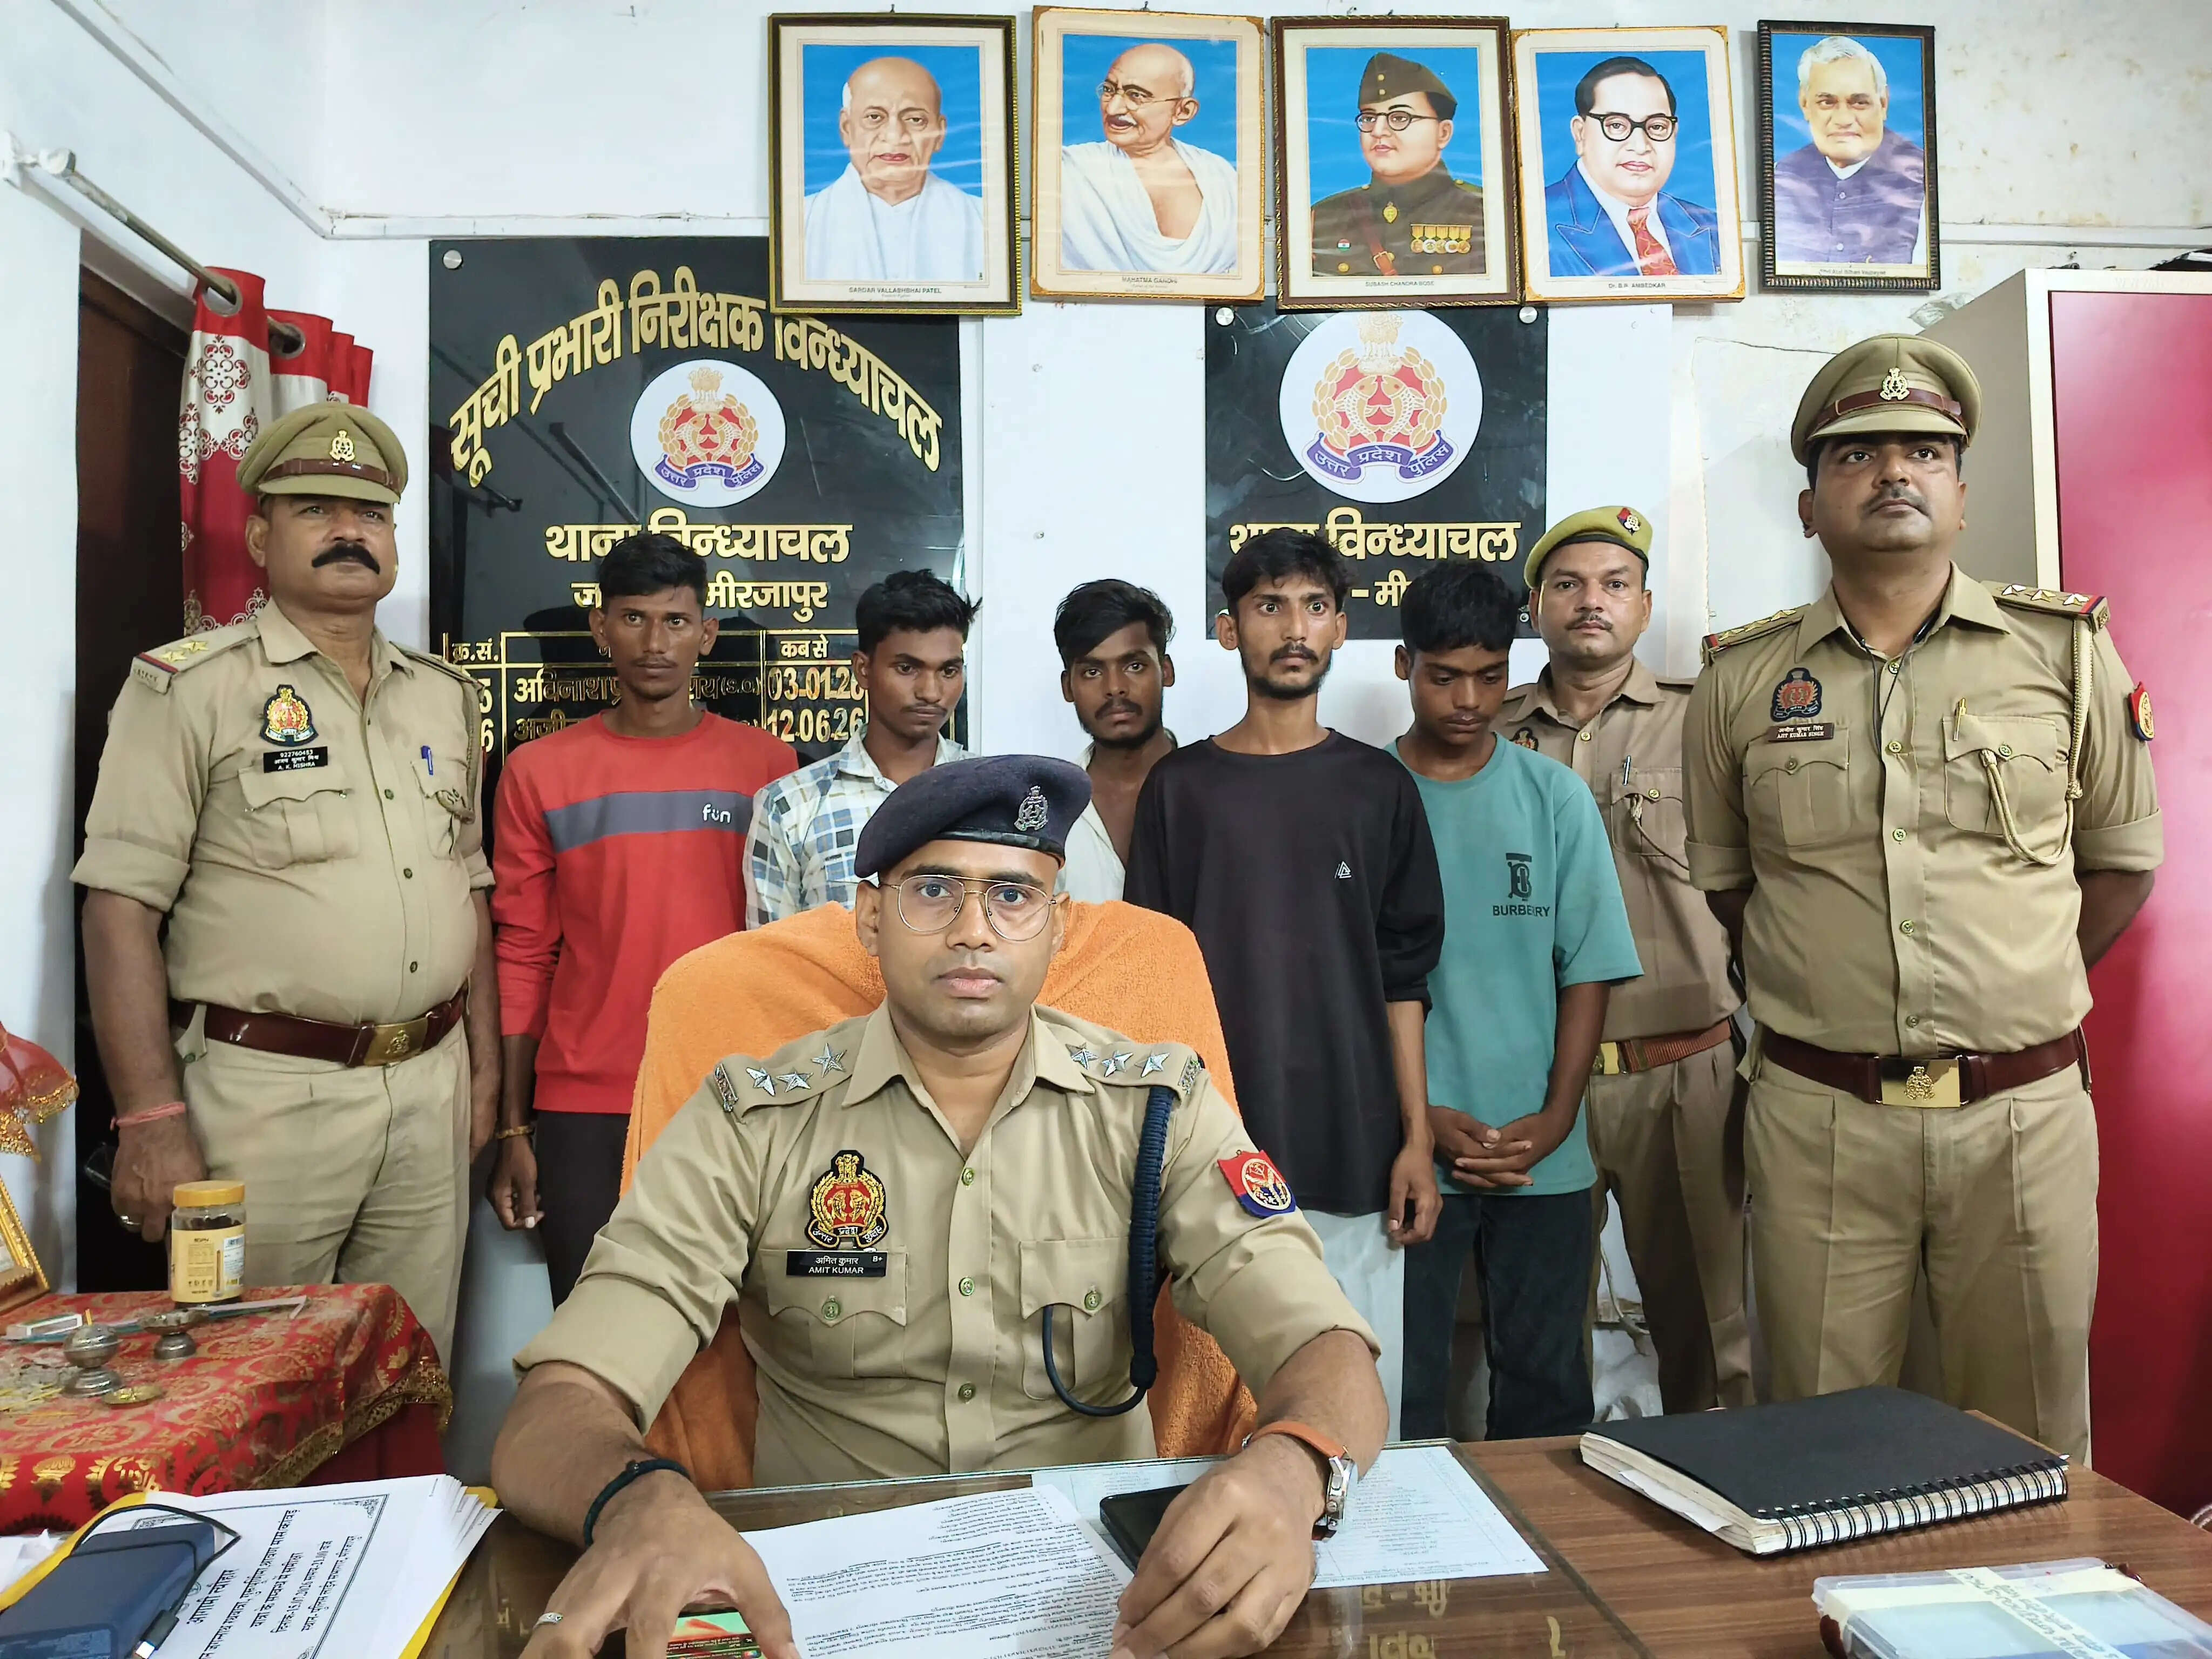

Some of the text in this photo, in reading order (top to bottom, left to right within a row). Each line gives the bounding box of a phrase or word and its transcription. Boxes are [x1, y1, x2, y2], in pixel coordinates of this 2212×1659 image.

[449, 265, 942, 488] सूची प्रभारी निरीक्षक विन्ध्याचल
[661, 463, 761, 486] उत्तर प्रदेश पुलिस
[1314, 444, 1450, 477] उत्तर प्रदेश पुलिस
[1325, 506, 1521, 562] विन्ध्याचल
[704, 570, 828, 623] मीरजापुर
[702, 803, 731, 824] fun
[1492, 905, 1550, 917] BURBERY
[815, 1256, 859, 1266] अमित कुमार
[186, 1595, 221, 1624] आगामी
